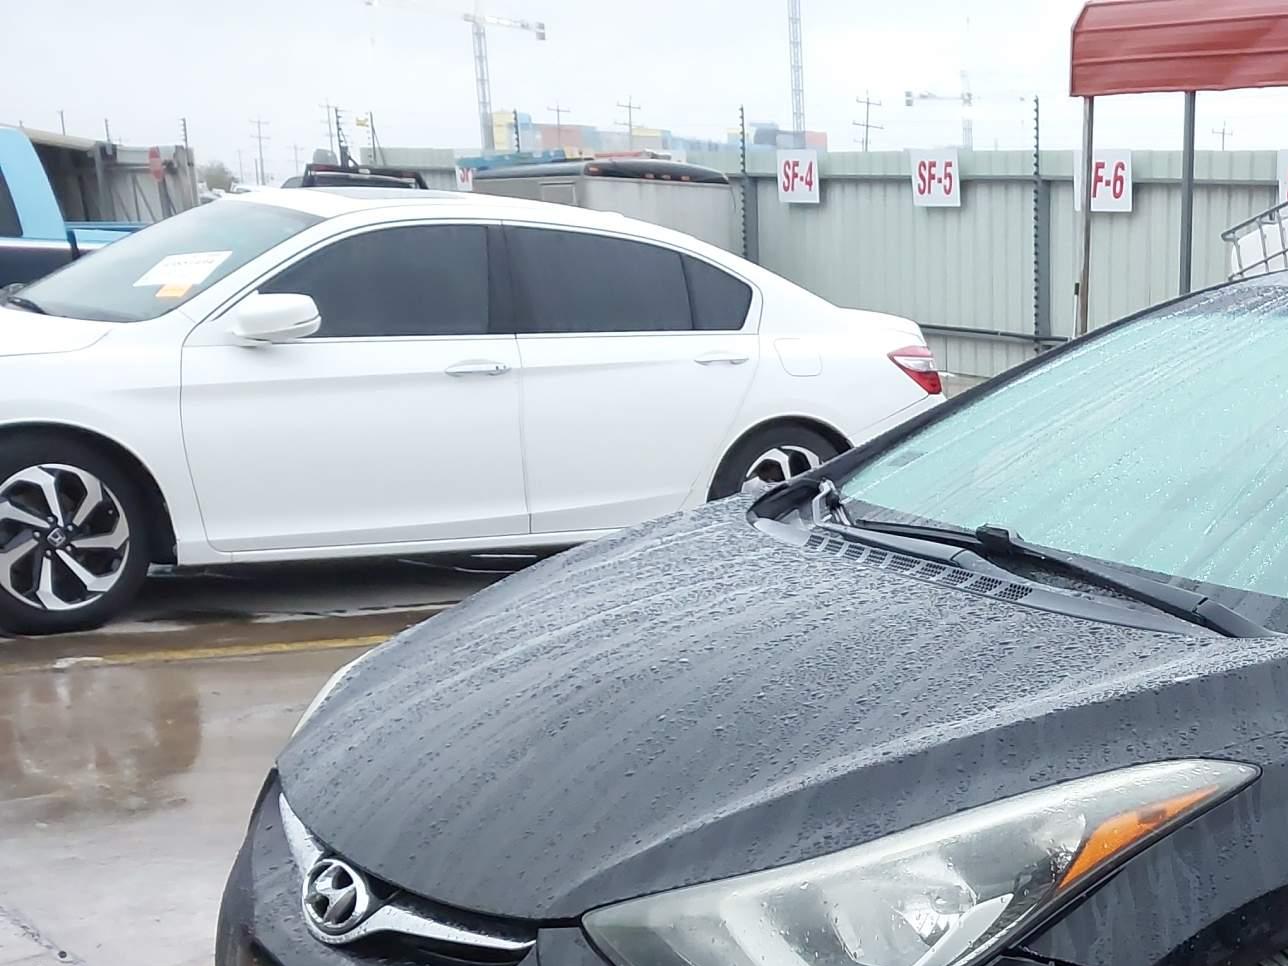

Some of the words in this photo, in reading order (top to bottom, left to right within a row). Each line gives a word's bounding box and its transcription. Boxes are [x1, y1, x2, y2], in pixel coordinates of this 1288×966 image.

[783, 160, 814, 192] SF-4
[917, 160, 953, 195] SF-5
[1091, 161, 1125, 199] F-6
